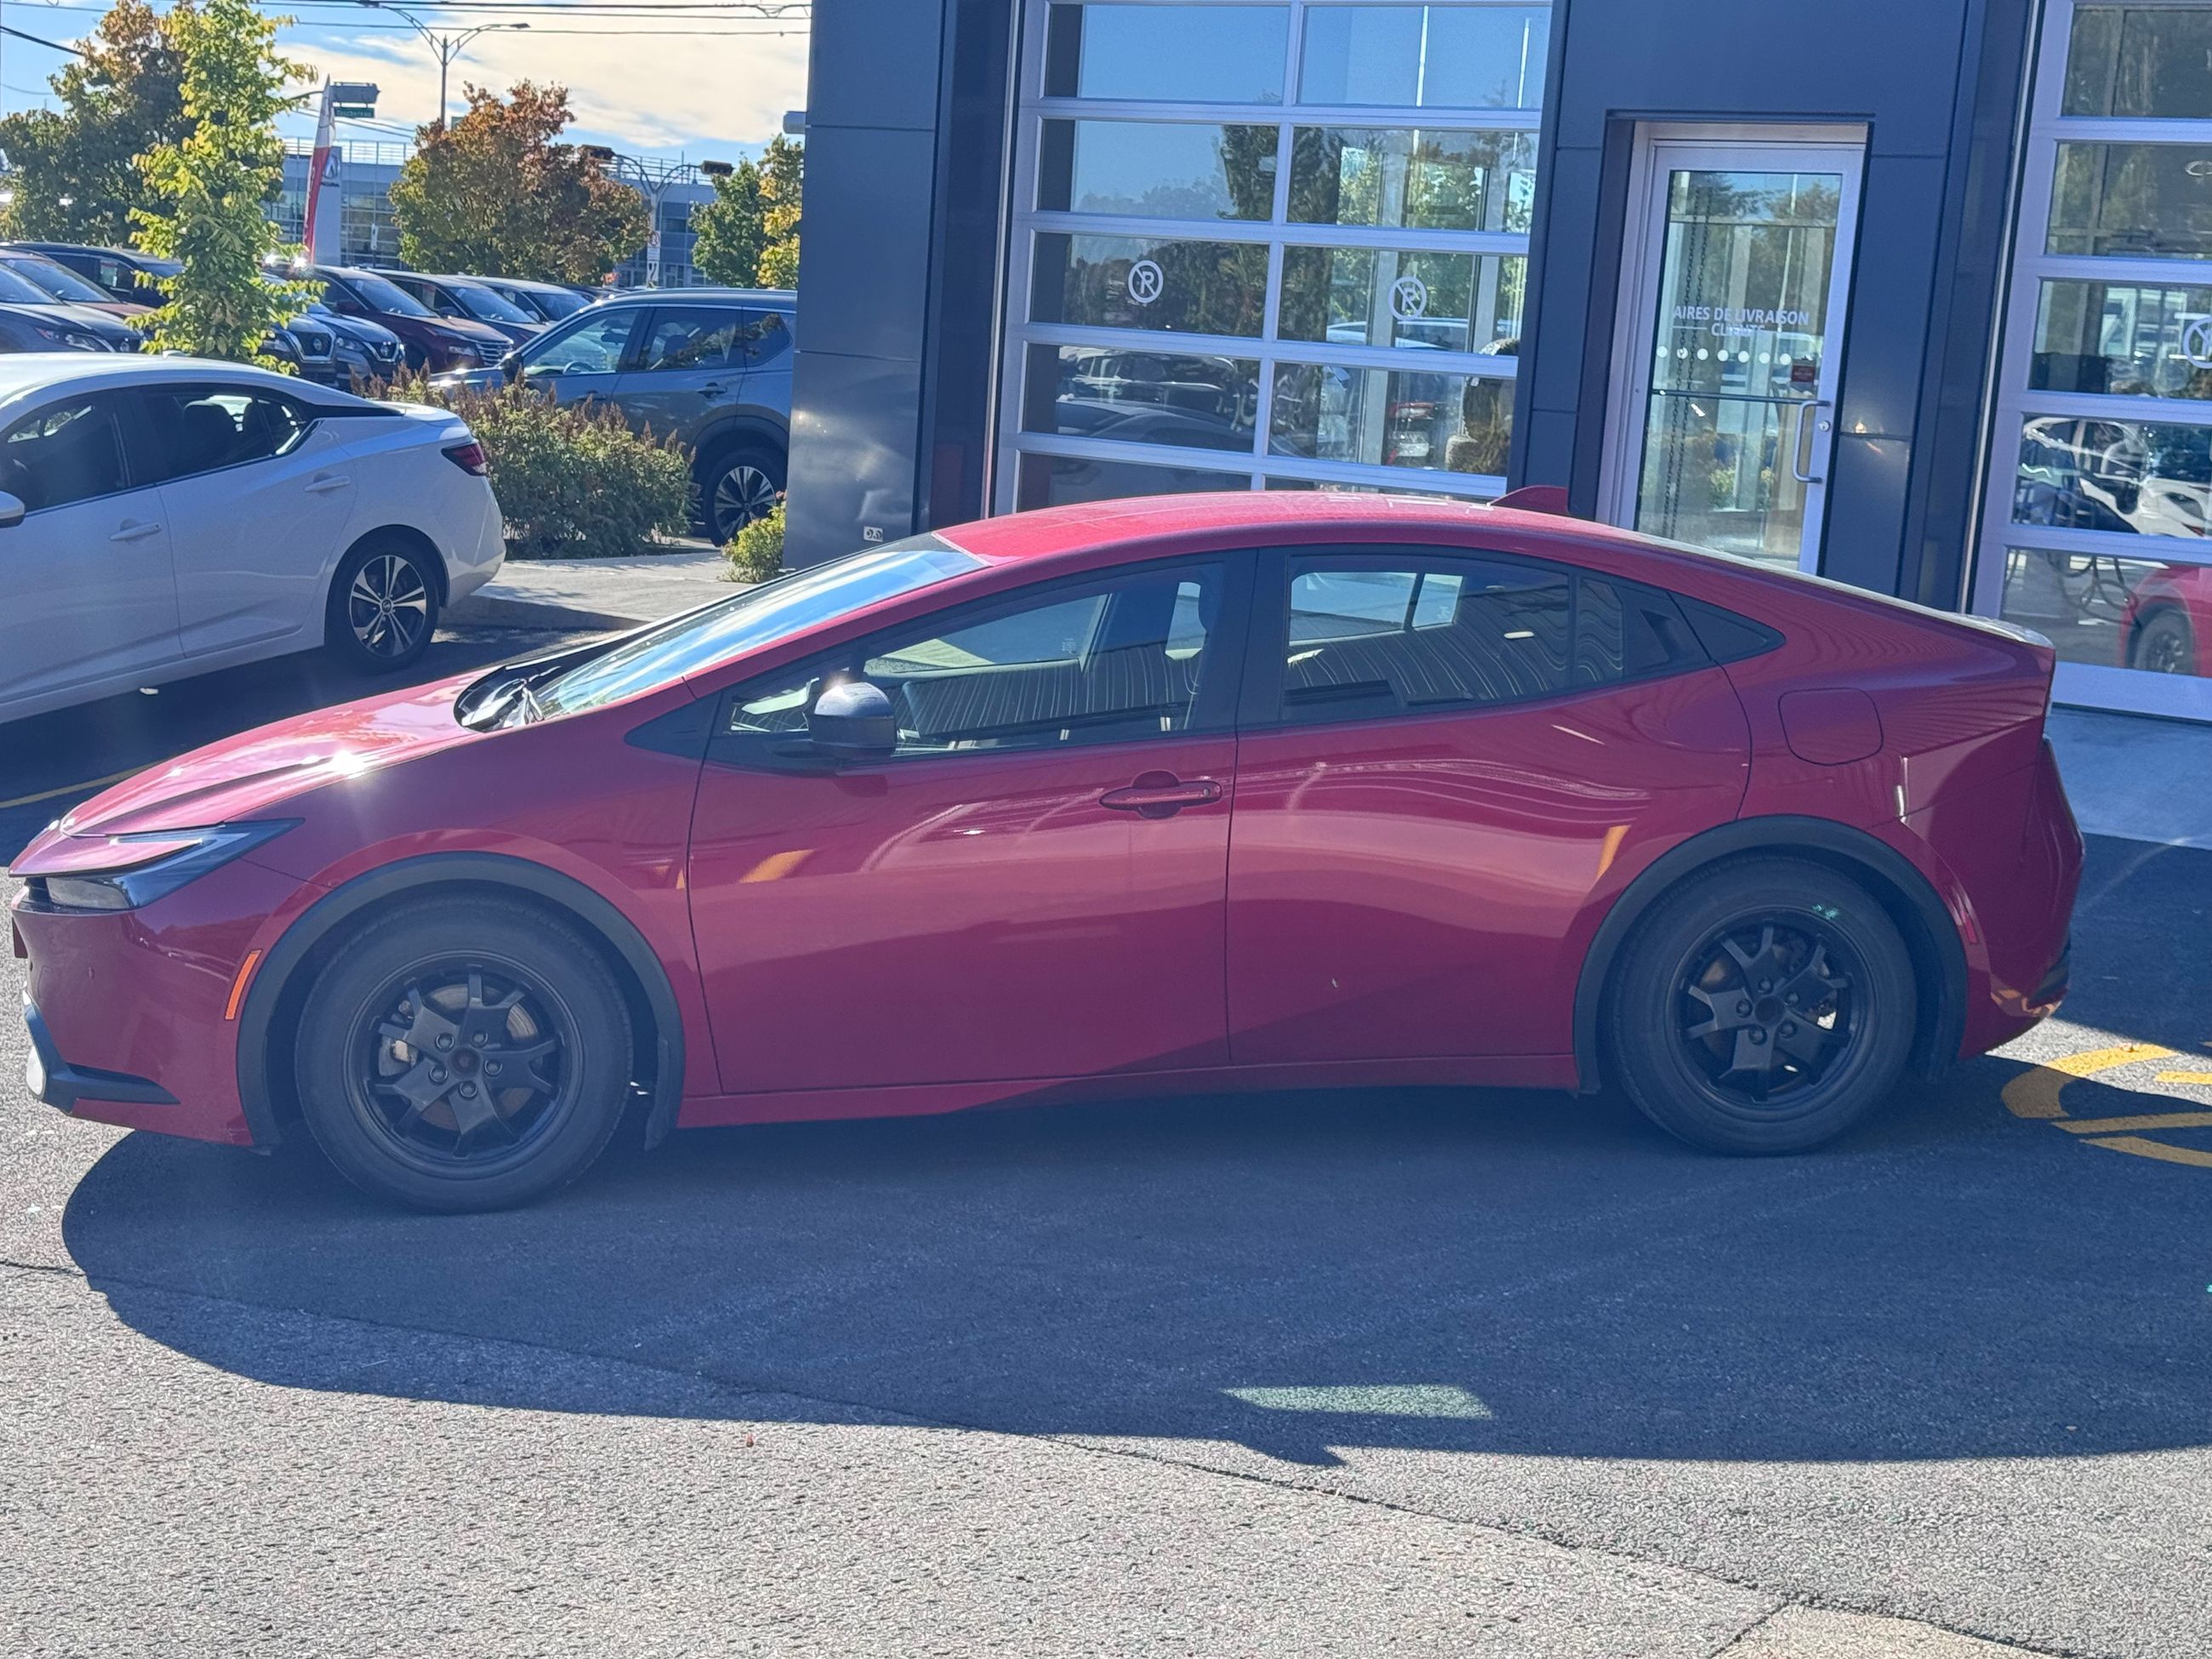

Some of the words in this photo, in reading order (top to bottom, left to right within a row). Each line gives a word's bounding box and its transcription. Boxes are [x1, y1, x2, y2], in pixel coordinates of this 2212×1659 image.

[1673, 305, 1710, 321] AIRES
[1713, 307, 1731, 322] DE
[1737, 308, 1809, 326] LIVRAISON
